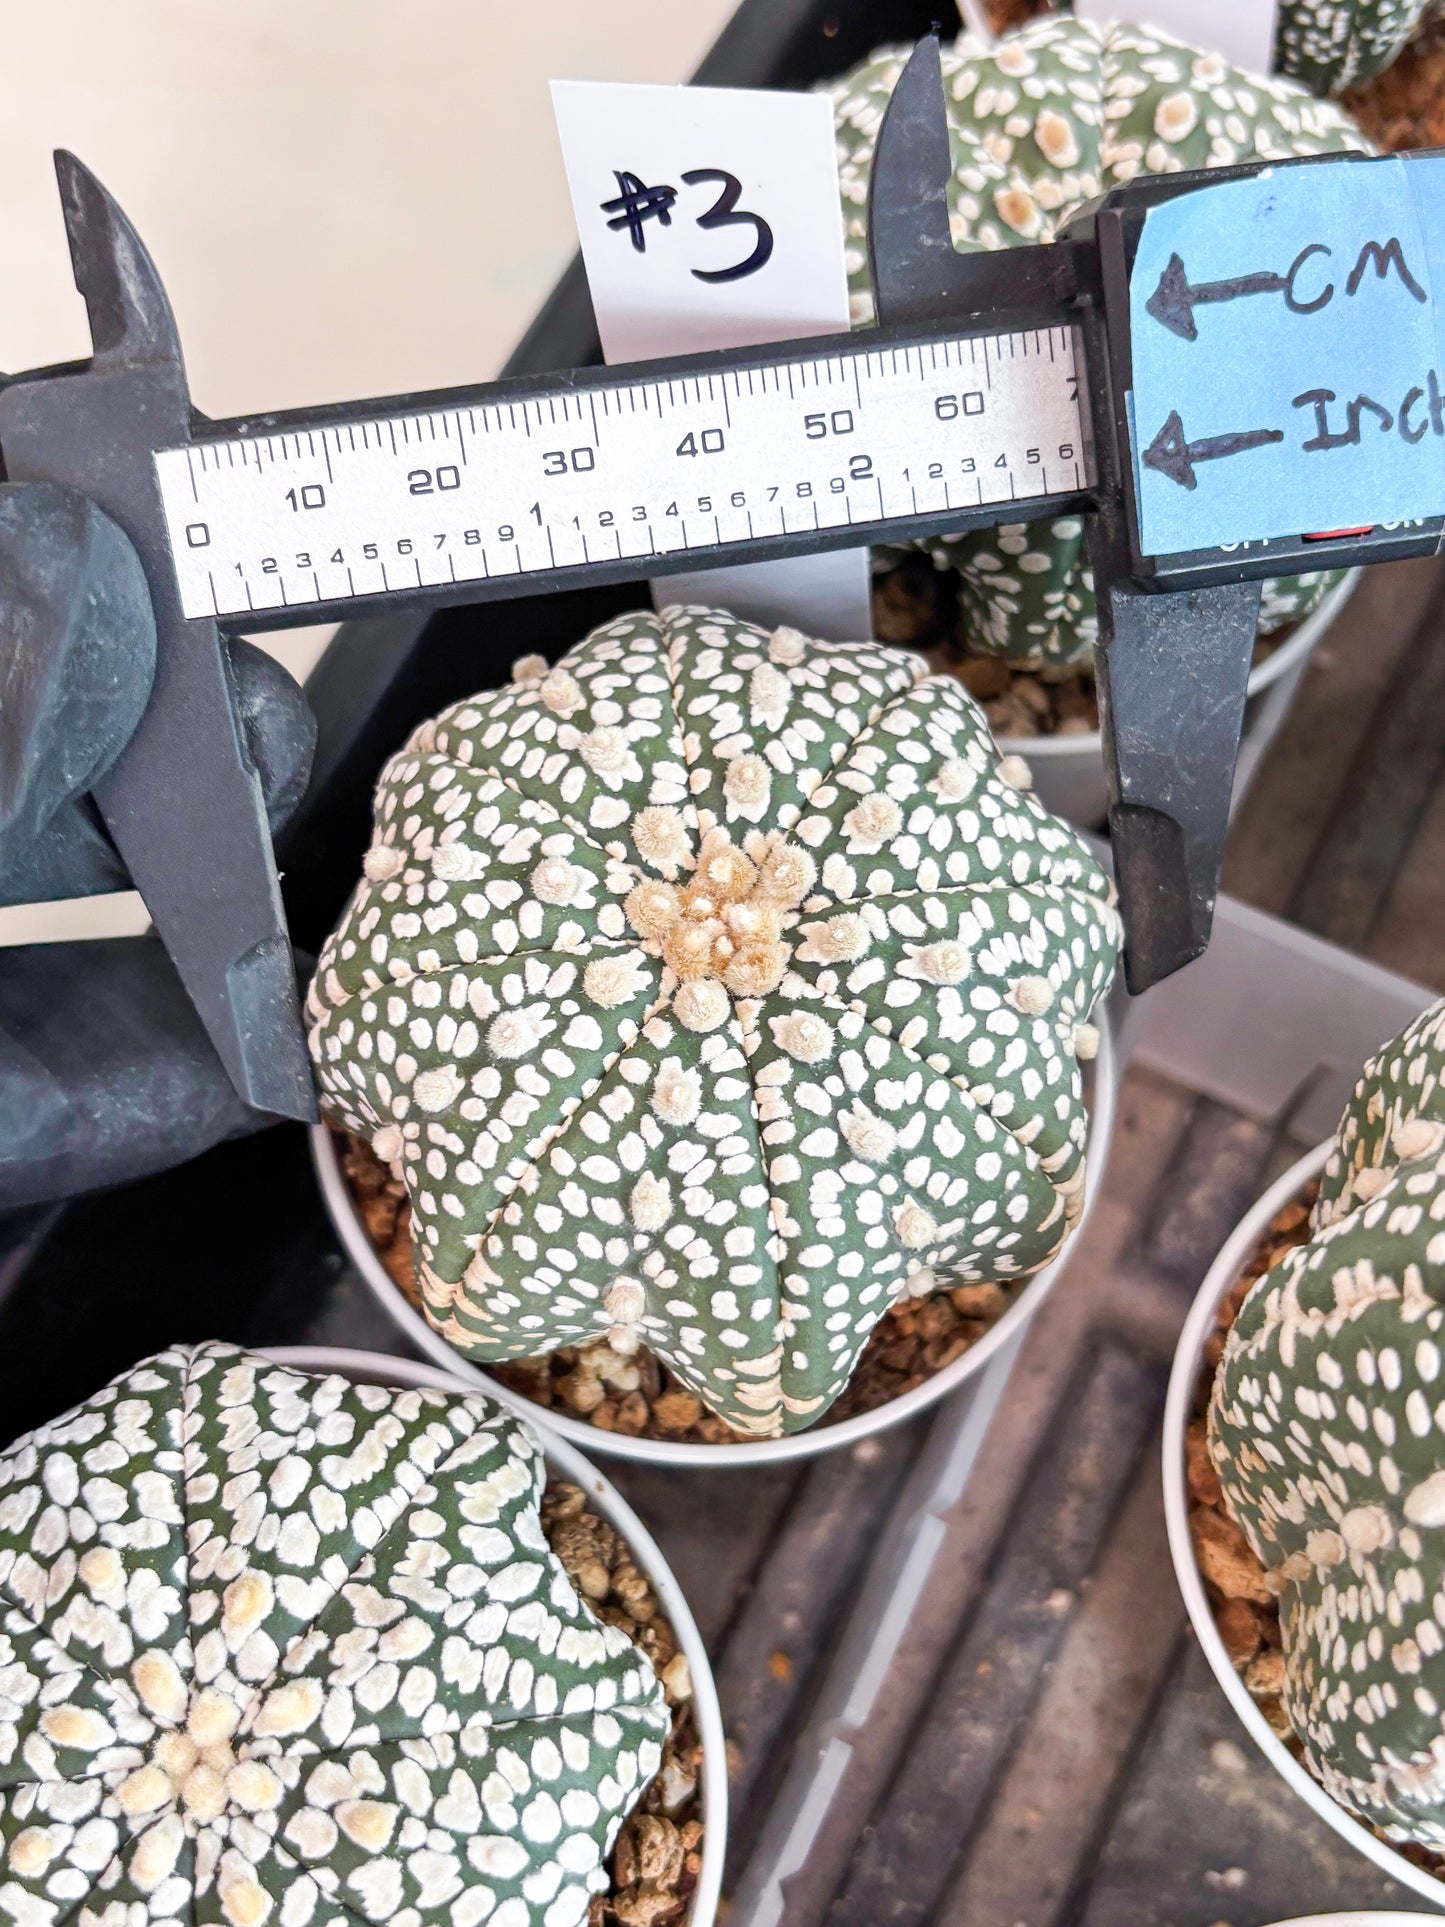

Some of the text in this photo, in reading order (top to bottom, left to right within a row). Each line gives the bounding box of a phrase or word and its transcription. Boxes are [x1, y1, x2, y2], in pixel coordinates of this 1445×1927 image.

[600, 168, 774, 284] #3
[1285, 237, 1427, 315] CM
[185, 522, 211, 549] 0
[284, 483, 326, 513] 10
[407, 465, 461, 497] 20
[542, 446, 596, 477] 30
[675, 428, 725, 458] 40
[803, 409, 855, 440] 50
[934, 390, 985, 422] 60
[234, 442, 1074, 578] 1 2 3 4 5 6 7 8 9 1 1 2 3 4 5 6 7 8 9 2 1 2 3 4 5 6
